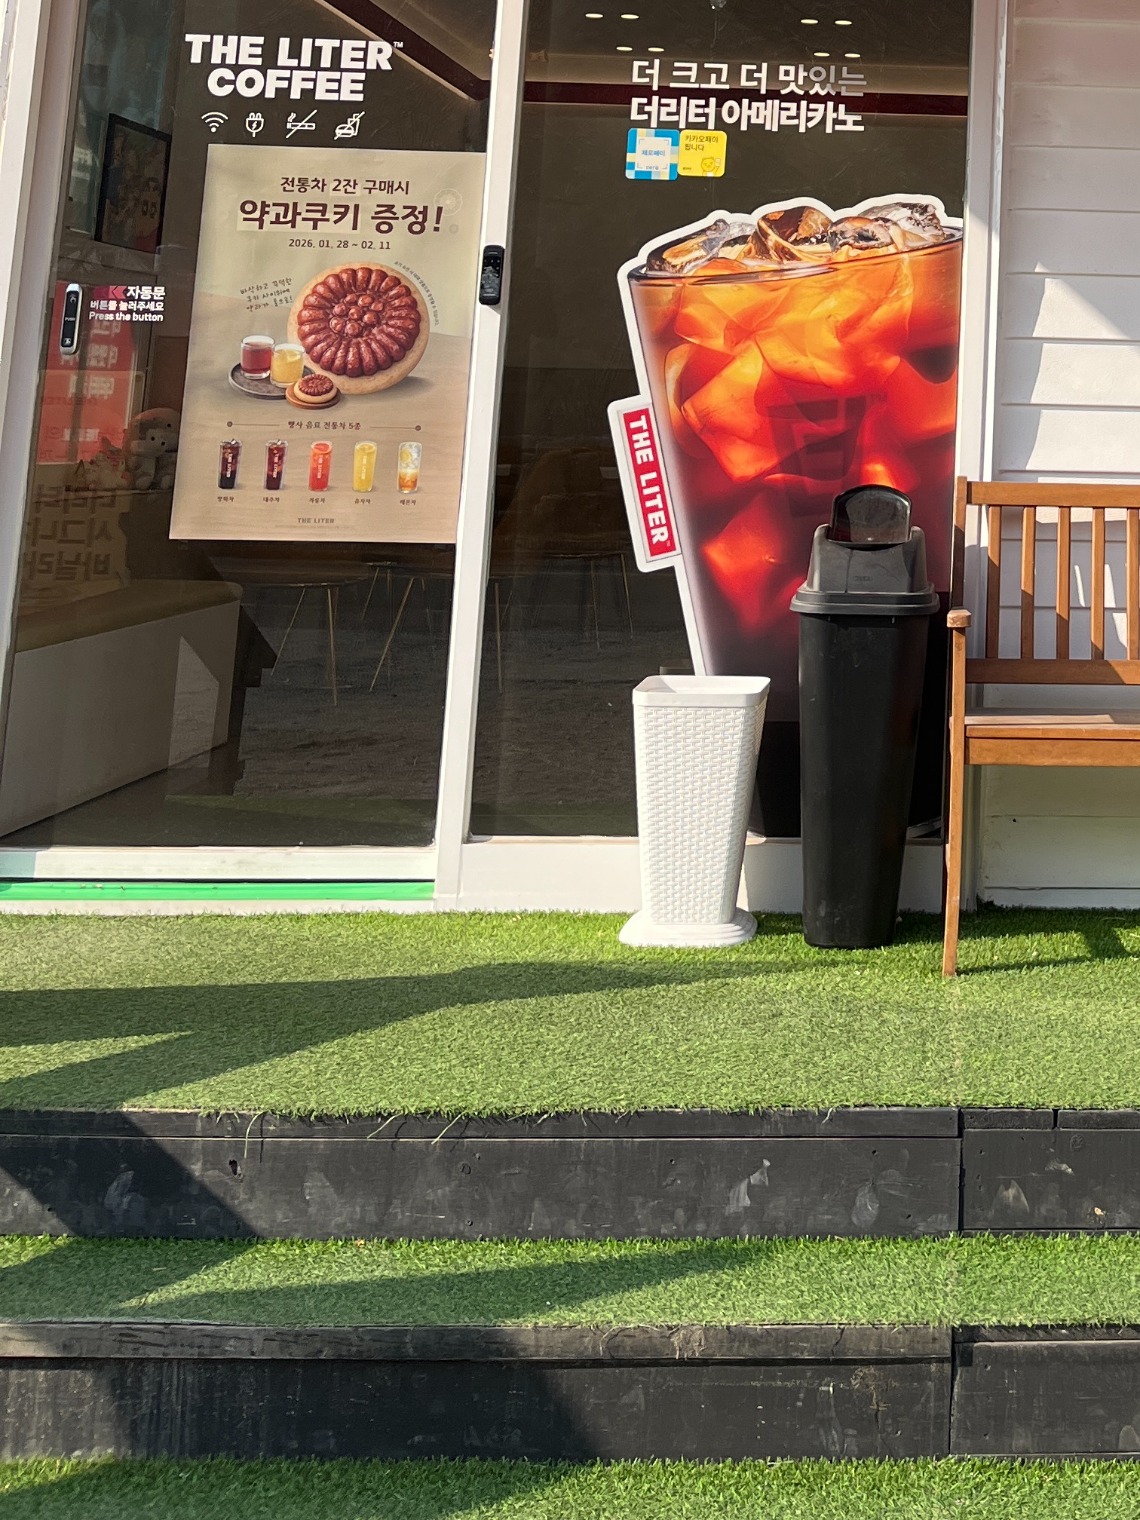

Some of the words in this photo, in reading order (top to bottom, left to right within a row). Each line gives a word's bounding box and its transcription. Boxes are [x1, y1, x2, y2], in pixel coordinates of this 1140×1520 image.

[184, 33, 265, 66] THE
[276, 37, 393, 71] LITER
[207, 67, 366, 102] COFFEE
[631, 58, 660, 92] 더
[669, 61, 730, 90] 크고
[740, 62, 768, 95] 더
[778, 63, 868, 97] 맛있는
[630, 95, 716, 130] 더리터
[721, 97, 865, 134] 아메리카노
[684, 134, 719, 144] 카카오페이
[280, 176, 327, 193] 전통차
[331, 178, 359, 195] 2잔
[362, 178, 410, 196] 구매시
[239, 199, 361, 231] 약과쿠키
[370, 202, 444, 236] 증정!
[288, 238, 316, 249] 2026.
[336, 239, 349, 249] 28
[379, 240, 391, 250] 11
[90, 300, 117, 311] 버튼을
[119, 300, 164, 311] 눌러주세요
[127, 285, 165, 300] 자동문
[89, 311, 114, 321] Press
[115, 311, 131, 321] the
[132, 312, 163, 322] button
[629, 415, 654, 465] THE
[640, 471, 669, 544] LITER
